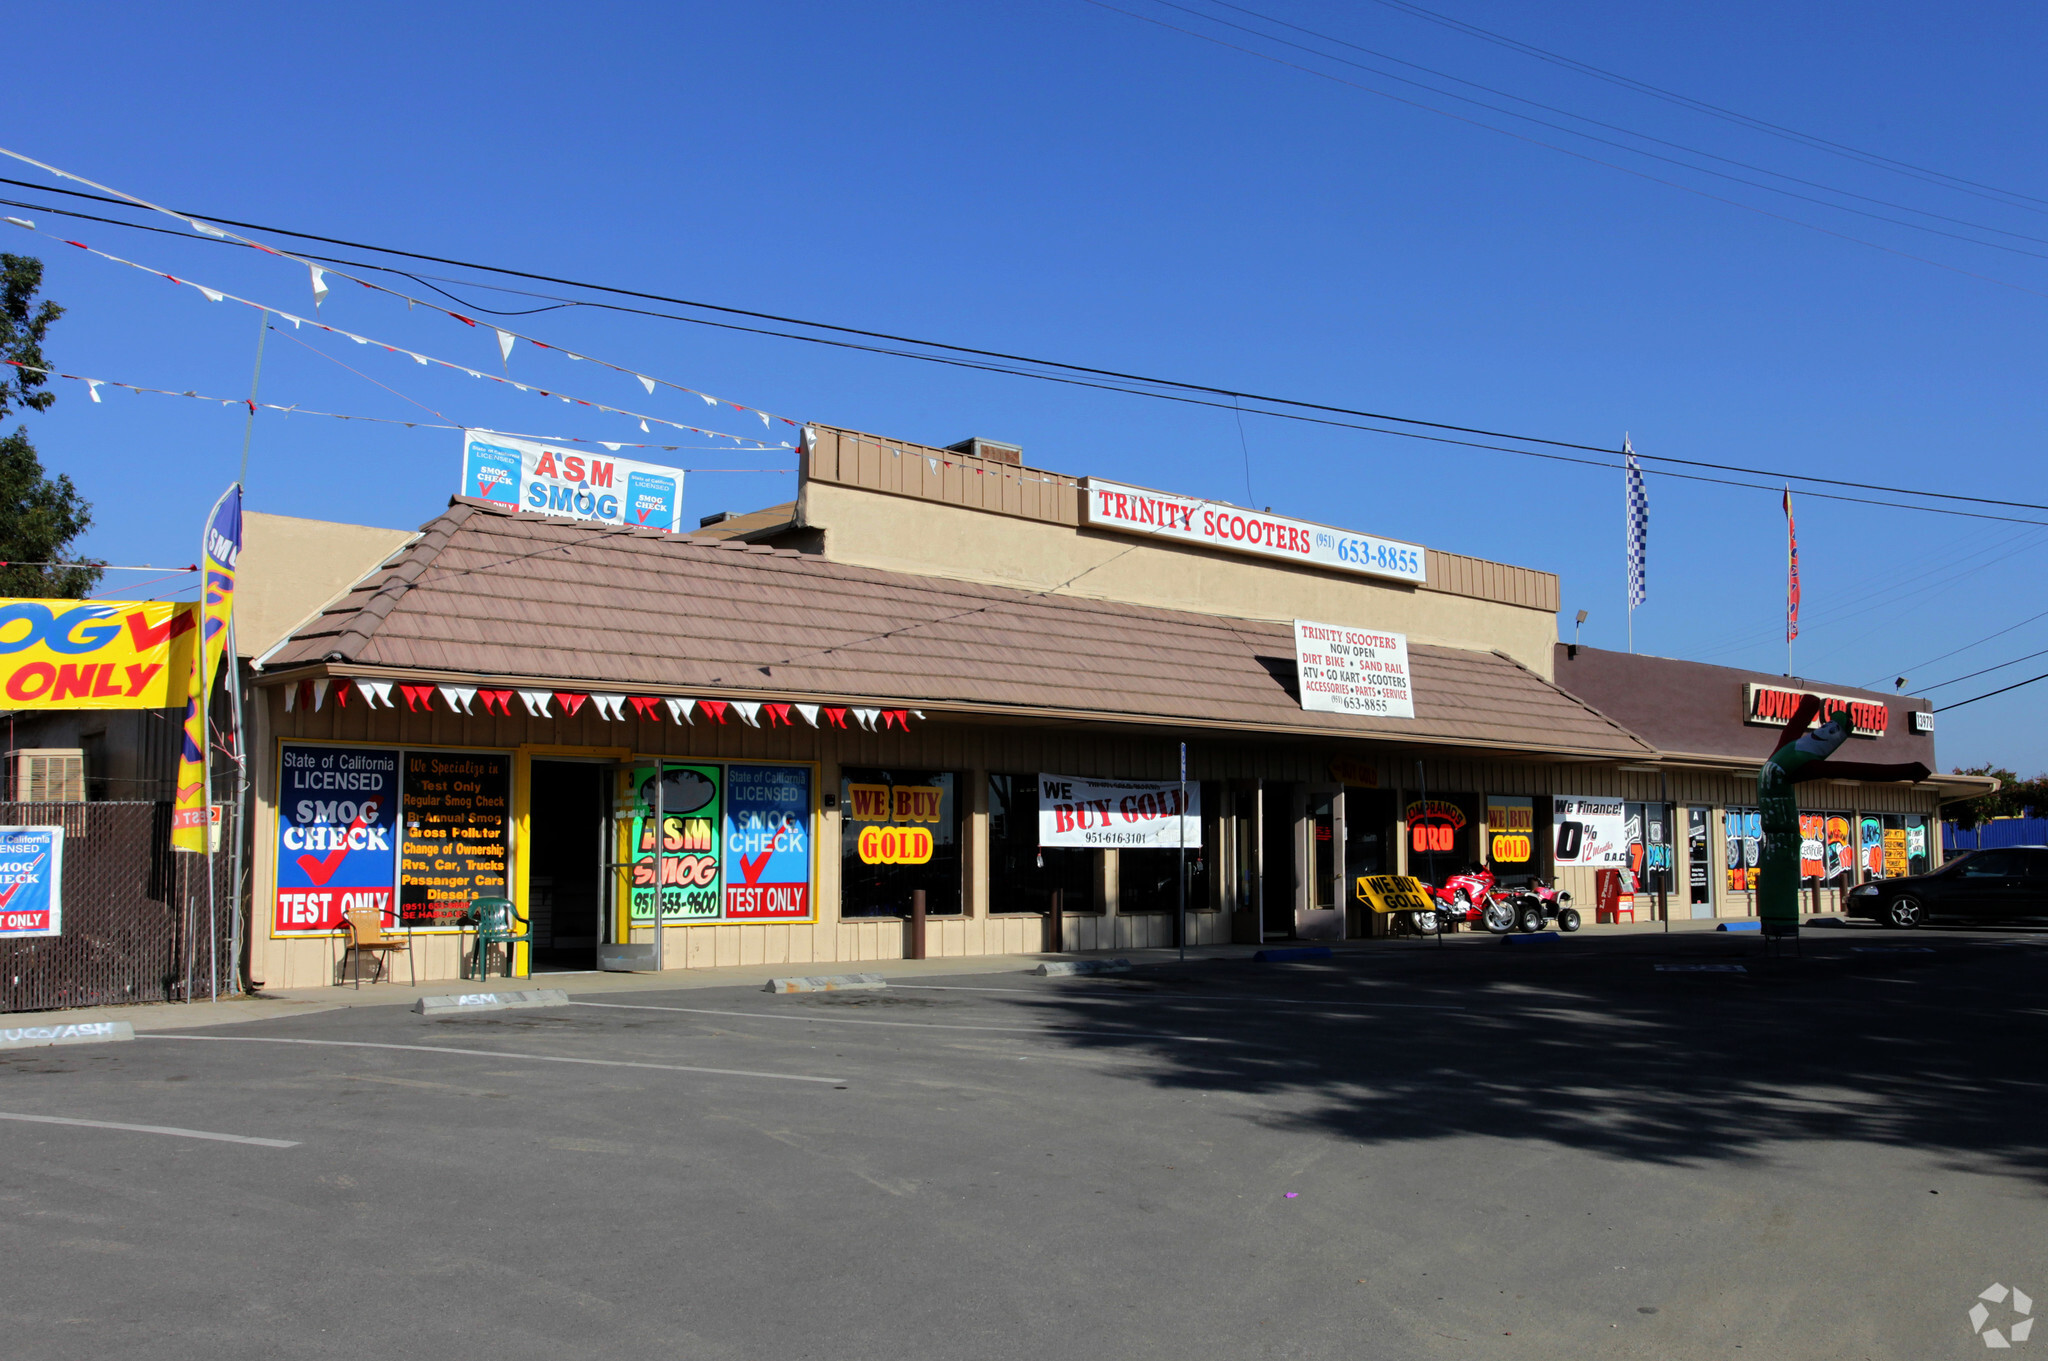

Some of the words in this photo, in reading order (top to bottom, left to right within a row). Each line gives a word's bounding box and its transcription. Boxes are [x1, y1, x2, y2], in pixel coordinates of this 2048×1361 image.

[476, 452, 515, 464] LICENSED
[477, 473, 513, 485] CHECK
[480, 466, 508, 477] SMOG
[635, 481, 670, 492] LICENSED
[528, 481, 618, 519] SMOG
[635, 501, 668, 512] CHECK
[638, 494, 664, 504] SMOG
[1099, 489, 1195, 532] TRINITY
[1204, 510, 1311, 555] SCOOTERS
[1315, 531, 1335, 551] (951)
[1338, 537, 1418, 574] 653-8855
[1302, 626, 1343, 643] TRINITY
[1346, 632, 1397, 650] SCOOTERS
[1330, 643, 1351, 655] NOW
[1352, 646, 1375, 658] OPEN
[1302, 652, 1323, 665] DIRT
[1325, 655, 1345, 668] BIKE
[1359, 659, 1383, 672] SAND
[1385, 662, 1404, 675] RAIL
[5, 661, 164, 702] ONLY
[1303, 666, 1319, 678] ATV
[1326, 669, 1338, 681] GO
[1339, 671, 1360, 683] KART
[1367, 673, 1407, 688] SCOOTERS
[1306, 680, 1350, 695] ACCESSORIES
[1355, 685, 1377, 697] PARTS
[1382, 688, 1408, 700] SERVICE
[1344, 697, 1388, 712] 653-8855
[1850, 702, 1888, 731] STEREO
[284, 752, 315, 768] State
[322, 754, 335, 769] of
[339, 754, 394, 772] California
[410, 759, 428, 774] We
[431, 758, 485, 778] Specialize
[488, 761, 499, 774] in
[294, 771, 383, 791] LICENSED
[421, 780, 447, 791] Test
[453, 780, 481, 793] Only
[730, 771, 751, 783] State
[754, 771, 763, 782] of
[765, 771, 806, 785] California
[735, 787, 798, 801] LICENSED
[1043, 781, 1073, 800] WE
[404, 794, 441, 807] Regular
[445, 795, 472, 809] Smog
[476, 795, 505, 808] Check
[853, 790, 885, 815] WE
[896, 791, 940, 816] BUY
[1053, 798, 1112, 833] BUY
[1120, 789, 1189, 823] GOLD
[1555, 800, 1573, 814] We
[1577, 801, 1622, 815] Finance!
[296, 799, 379, 824] SMOG
[407, 812, 465, 823] Bi-Annual
[468, 812, 502, 825] Smog
[738, 811, 796, 830] SMOG
[1489, 810, 1506, 829] WE
[1509, 810, 1532, 829] BUY
[1693, 811, 1699, 821] A
[6, 835, 50, 844] California
[283, 827, 389, 851] CHECK
[408, 827, 447, 839] Gross
[452, 827, 501, 839] Polluter
[640, 817, 712, 851] ASM
[1085, 832, 1146, 844] 951-616-3101
[1413, 823, 1454, 852] ORO
[403, 842, 439, 857] Change
[442, 843, 453, 855] of
[455, 843, 505, 858] Ownership
[730, 833, 803, 853] CHECK
[863, 832, 928, 859] GOLD
[1495, 839, 1527, 859] GOLD
[1582, 842, 1593, 862] 12
[1593, 841, 1613, 857] Months
[402, 859, 430, 872] Rvs,
[435, 860, 461, 872] Car,
[465, 860, 505, 871] Trucks
[1630, 843, 1644, 872] 7
[402, 874, 470, 888] Passanger
[475, 875, 505, 886] Cars
[634, 856, 717, 887] SMOG
[1366, 877, 1394, 894] WE
[1391, 876, 1420, 893] BUY
[279, 892, 339, 925] TEST
[402, 903, 426, 913] (951)
[728, 887, 763, 912] TEST
[766, 887, 804, 912] ONLY
[1384, 895, 1424, 909] GOLD
[8, 913, 42, 927] ONLY
[402, 911, 417, 920] SE
[458, 993, 497, 1006] ASM
